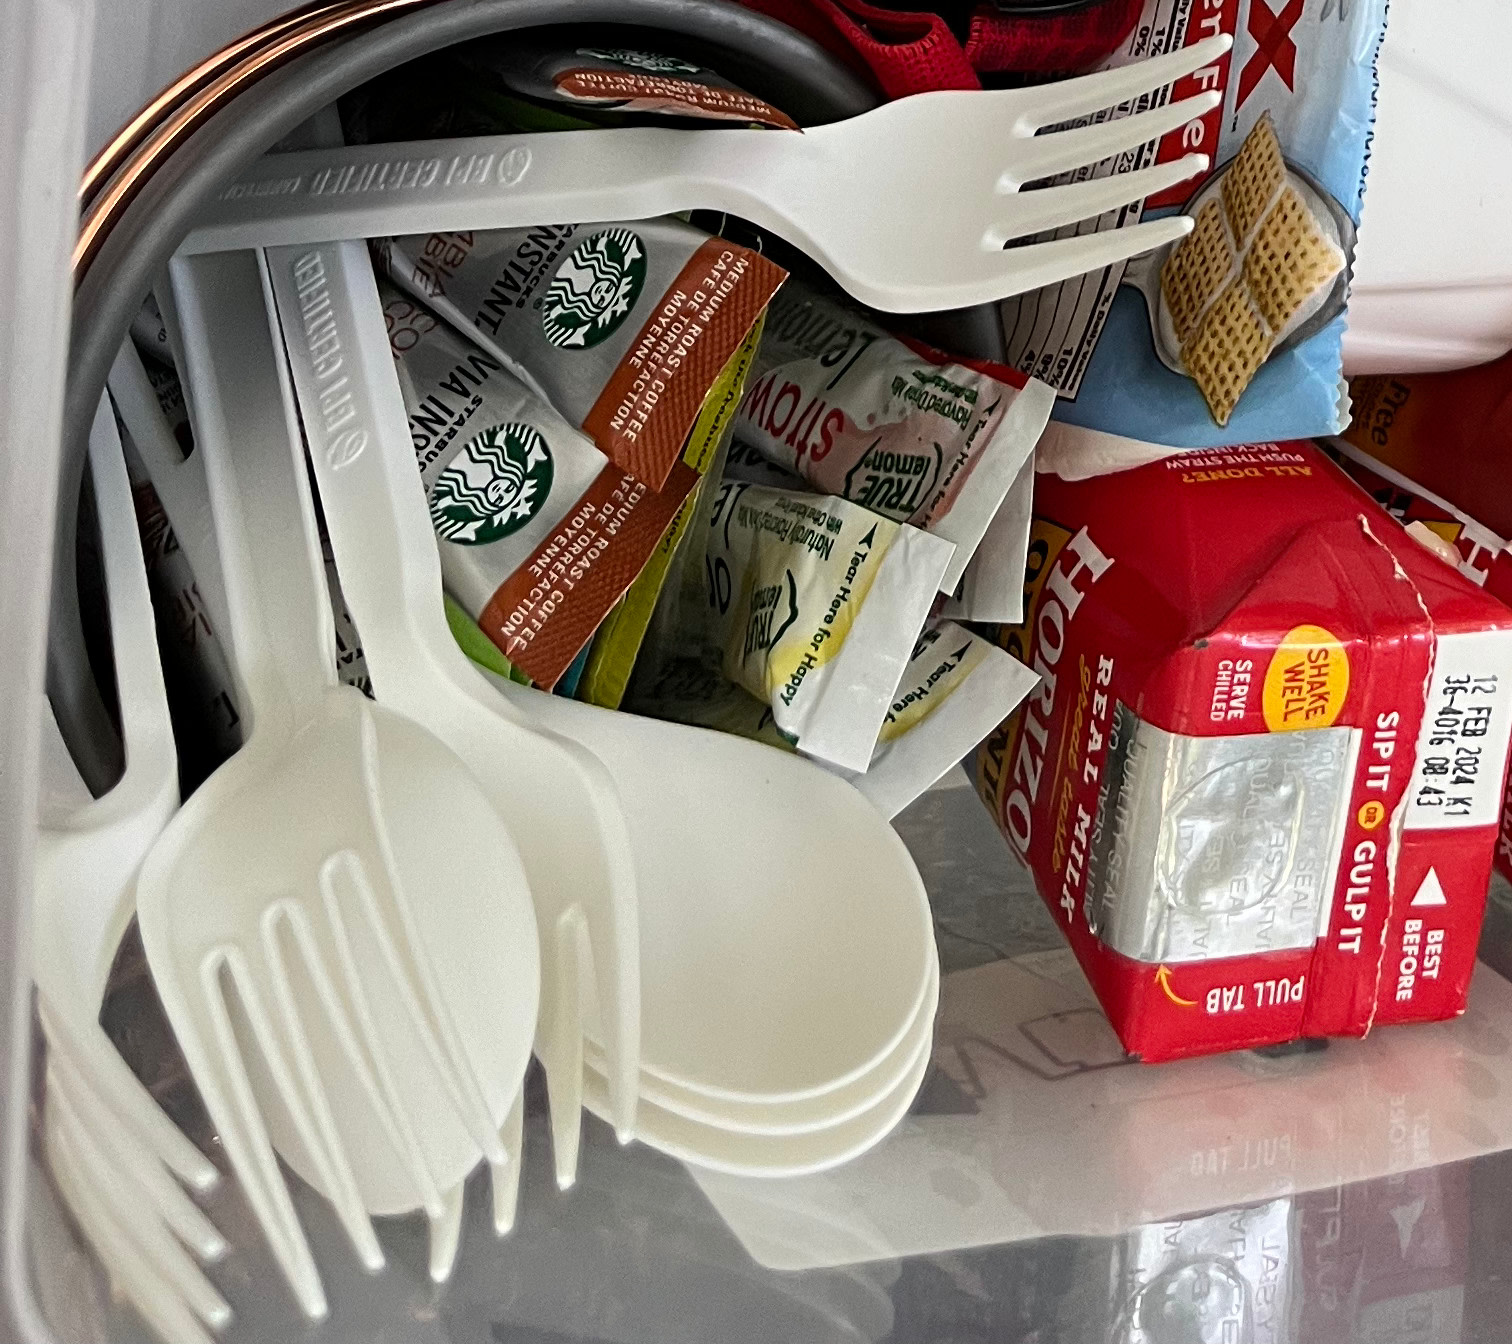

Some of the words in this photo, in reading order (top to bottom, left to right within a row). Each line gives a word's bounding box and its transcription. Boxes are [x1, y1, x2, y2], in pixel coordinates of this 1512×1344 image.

[698, 257, 751, 325] MEDIUM
[628, 289, 688, 368] MOYENNE
[663, 322, 704, 382] ROAST
[439, 355, 501, 404] VIA
[622, 378, 667, 444] COFFEE
[1181, 466, 1265, 484] DONE?
[1264, 465, 1313, 477] ALL
[528, 501, 597, 578] MOYENNE
[568, 539, 611, 591] ROAST
[847, 550, 868, 585] Tear
[823, 585, 852, 630] Here
[810, 631, 833, 656] for
[779, 654, 819, 707] Happy
[1006, 525, 1115, 855] HORIZO
[1209, 658, 1234, 722] CHILLED
[1227, 658, 1253, 721] SERVE
[1281, 661, 1307, 724] WELL
[1305, 647, 1331, 722] SHAKE
[1470, 673, 1499, 696] 12
[1084, 653, 1115, 785] REAL
[1370, 710, 1400, 764] SIP
[1460, 706, 1493, 739] FEB
[1365, 765, 1393, 793] IT
[1449, 746, 1483, 786] 2024
[1443, 795, 1474, 817] K1
[1060, 802, 1092, 924] MILK
[1345, 840, 1377, 924] GULP
[1337, 925, 1363, 954] IT
[1395, 918, 1424, 1002] BEFORE
[1422, 927, 1445, 980] BEST
[1205, 987, 1247, 1015] TAB
[1256, 974, 1306, 1008] PULL
